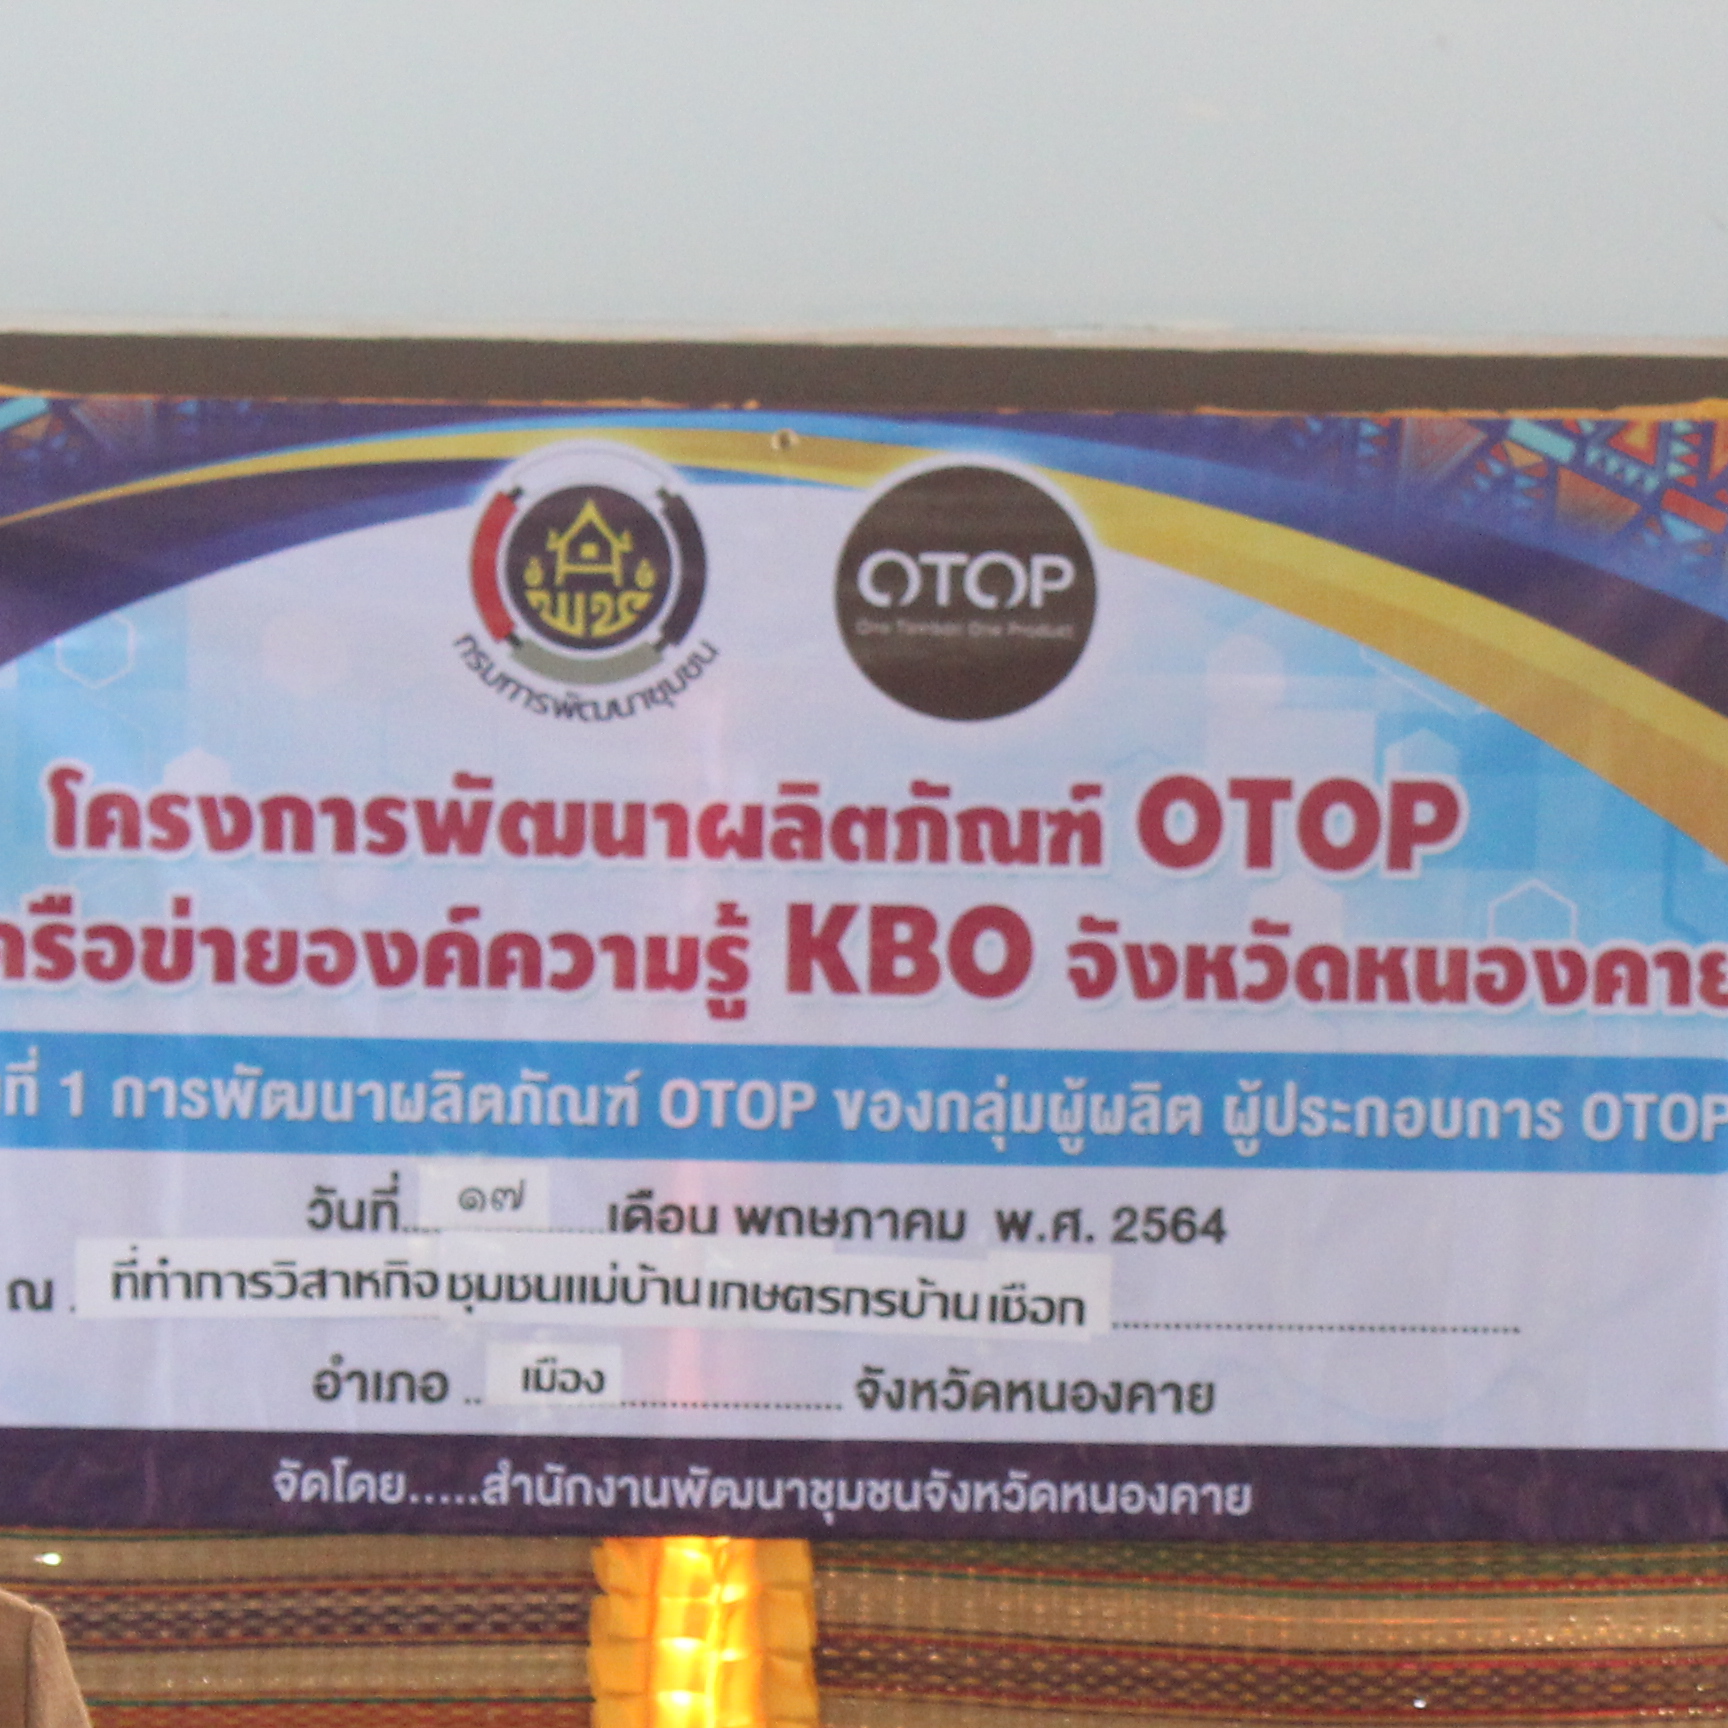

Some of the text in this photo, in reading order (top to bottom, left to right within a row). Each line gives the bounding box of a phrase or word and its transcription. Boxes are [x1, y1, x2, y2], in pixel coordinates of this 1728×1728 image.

[856, 548, 1077, 610] OTOP
[452, 633, 720, 722] กรมการพัฒนาชุมชน
[51, 767, 1459, 871] โครงการพัฒนาผลิตภัณฑ์ OTOP
[788, 903, 1033, 999] KBO
[60, 1069, 84, 1117] 1
[111, 1062, 641, 1126] การพัฒนาผลิตภัณฑ์
[659, 1077, 816, 1130] OTOP
[833, 1075, 1201, 1154] ของกลุ่มผู้ผลิต
[1223, 1079, 1562, 1156] ผู้ประกอบการ
[456, 1178, 526, 1213] ๑๗
[995, 1203, 1095, 1244] พ.ศ.
[1111, 1205, 1227, 1245] 2564
[521, 1354, 607, 1396] เมือง
[855, 1363, 1216, 1416] จังหวัดหนองคาย
